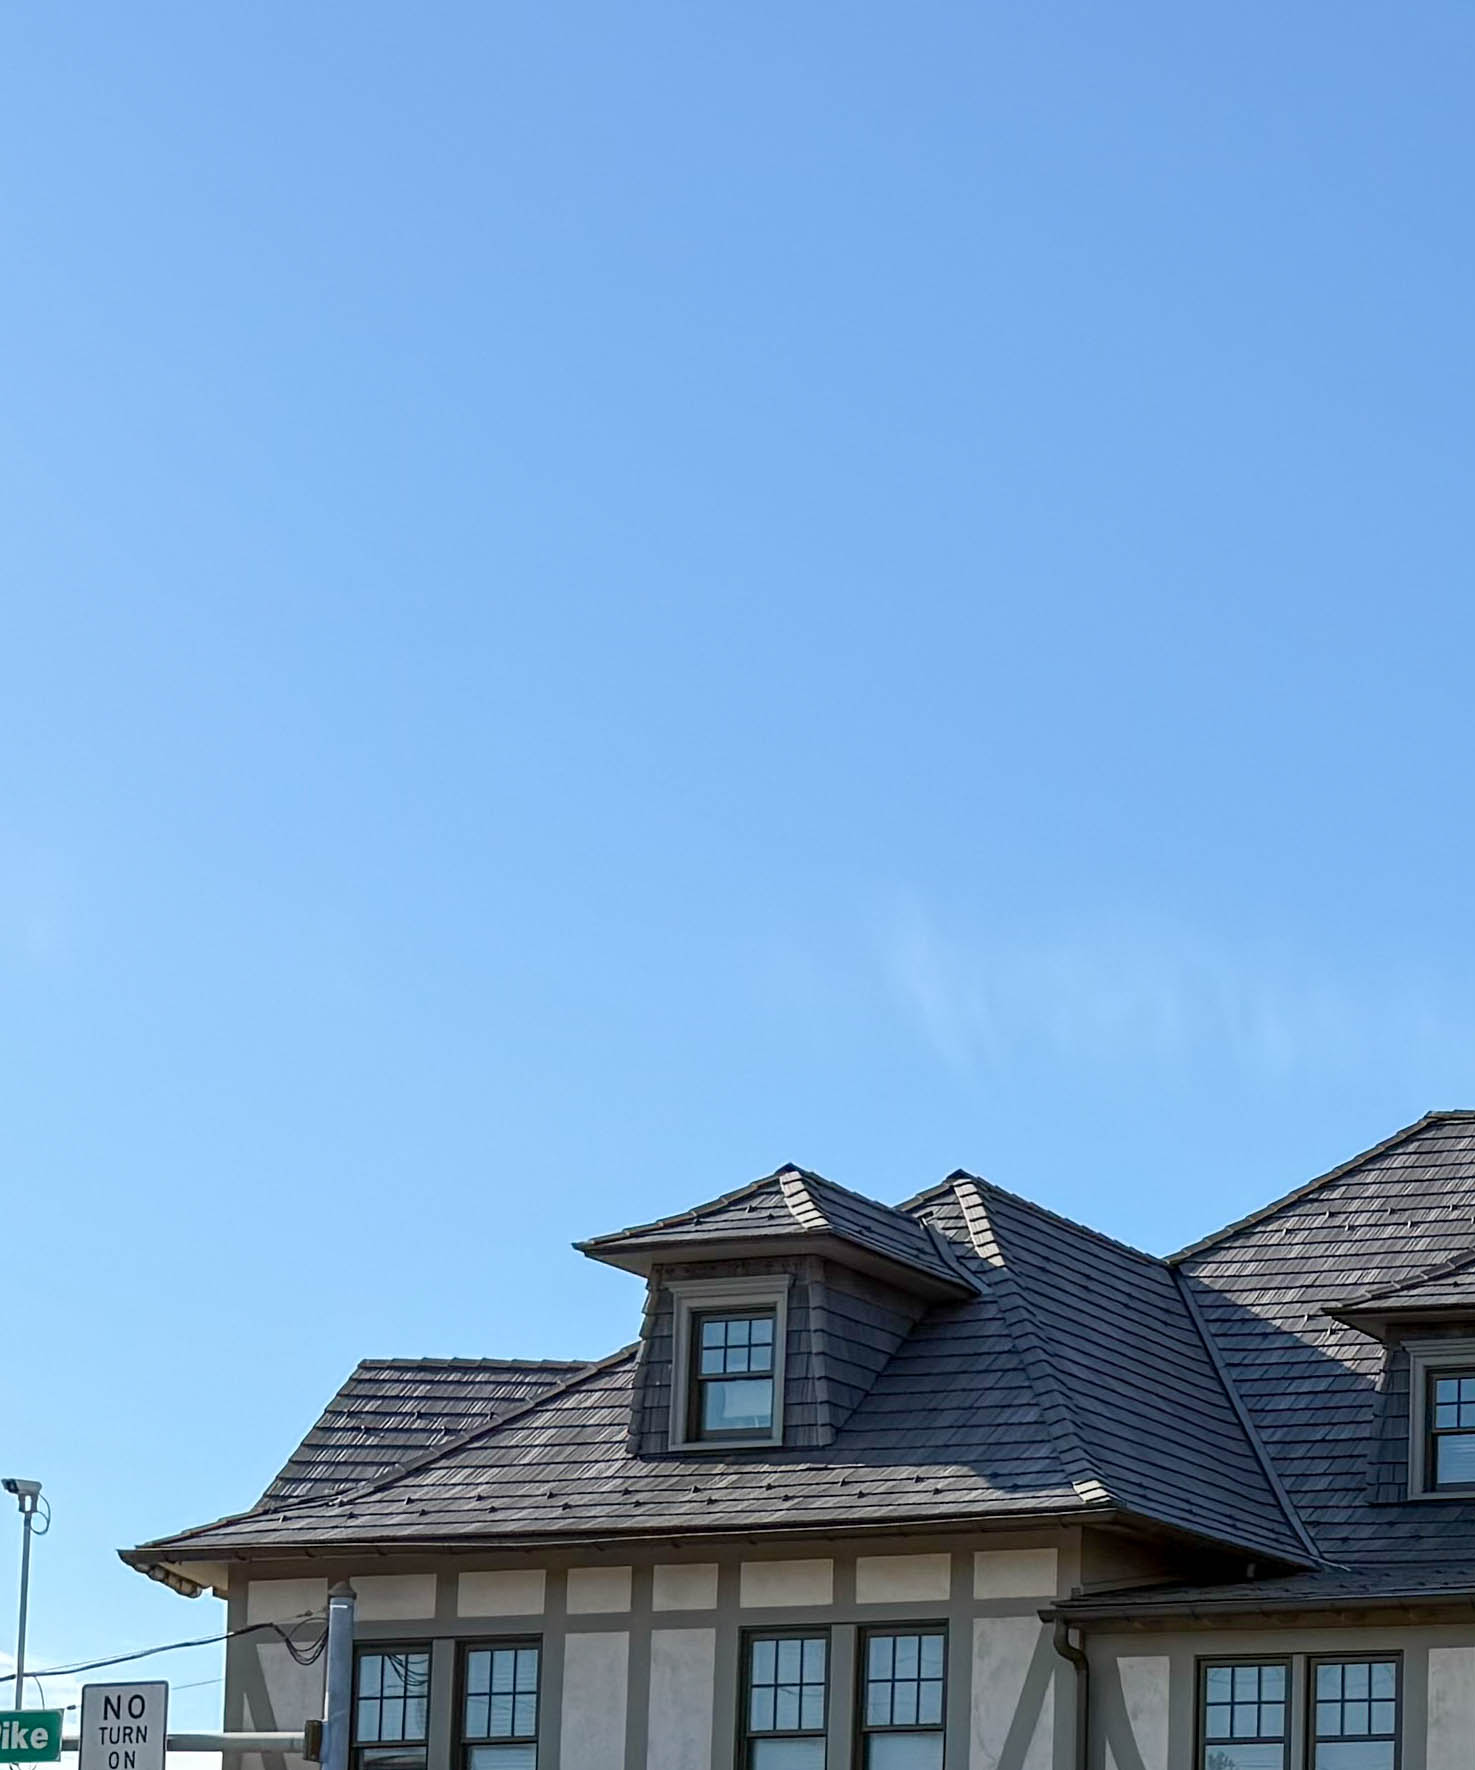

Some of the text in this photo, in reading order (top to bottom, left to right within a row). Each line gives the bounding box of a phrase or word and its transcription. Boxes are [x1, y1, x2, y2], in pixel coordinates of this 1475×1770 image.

[103, 1694, 145, 1720] NO
[0, 1721, 48, 1750] ike
[99, 1725, 147, 1745] TURN
[108, 1751, 136, 1770] ON
